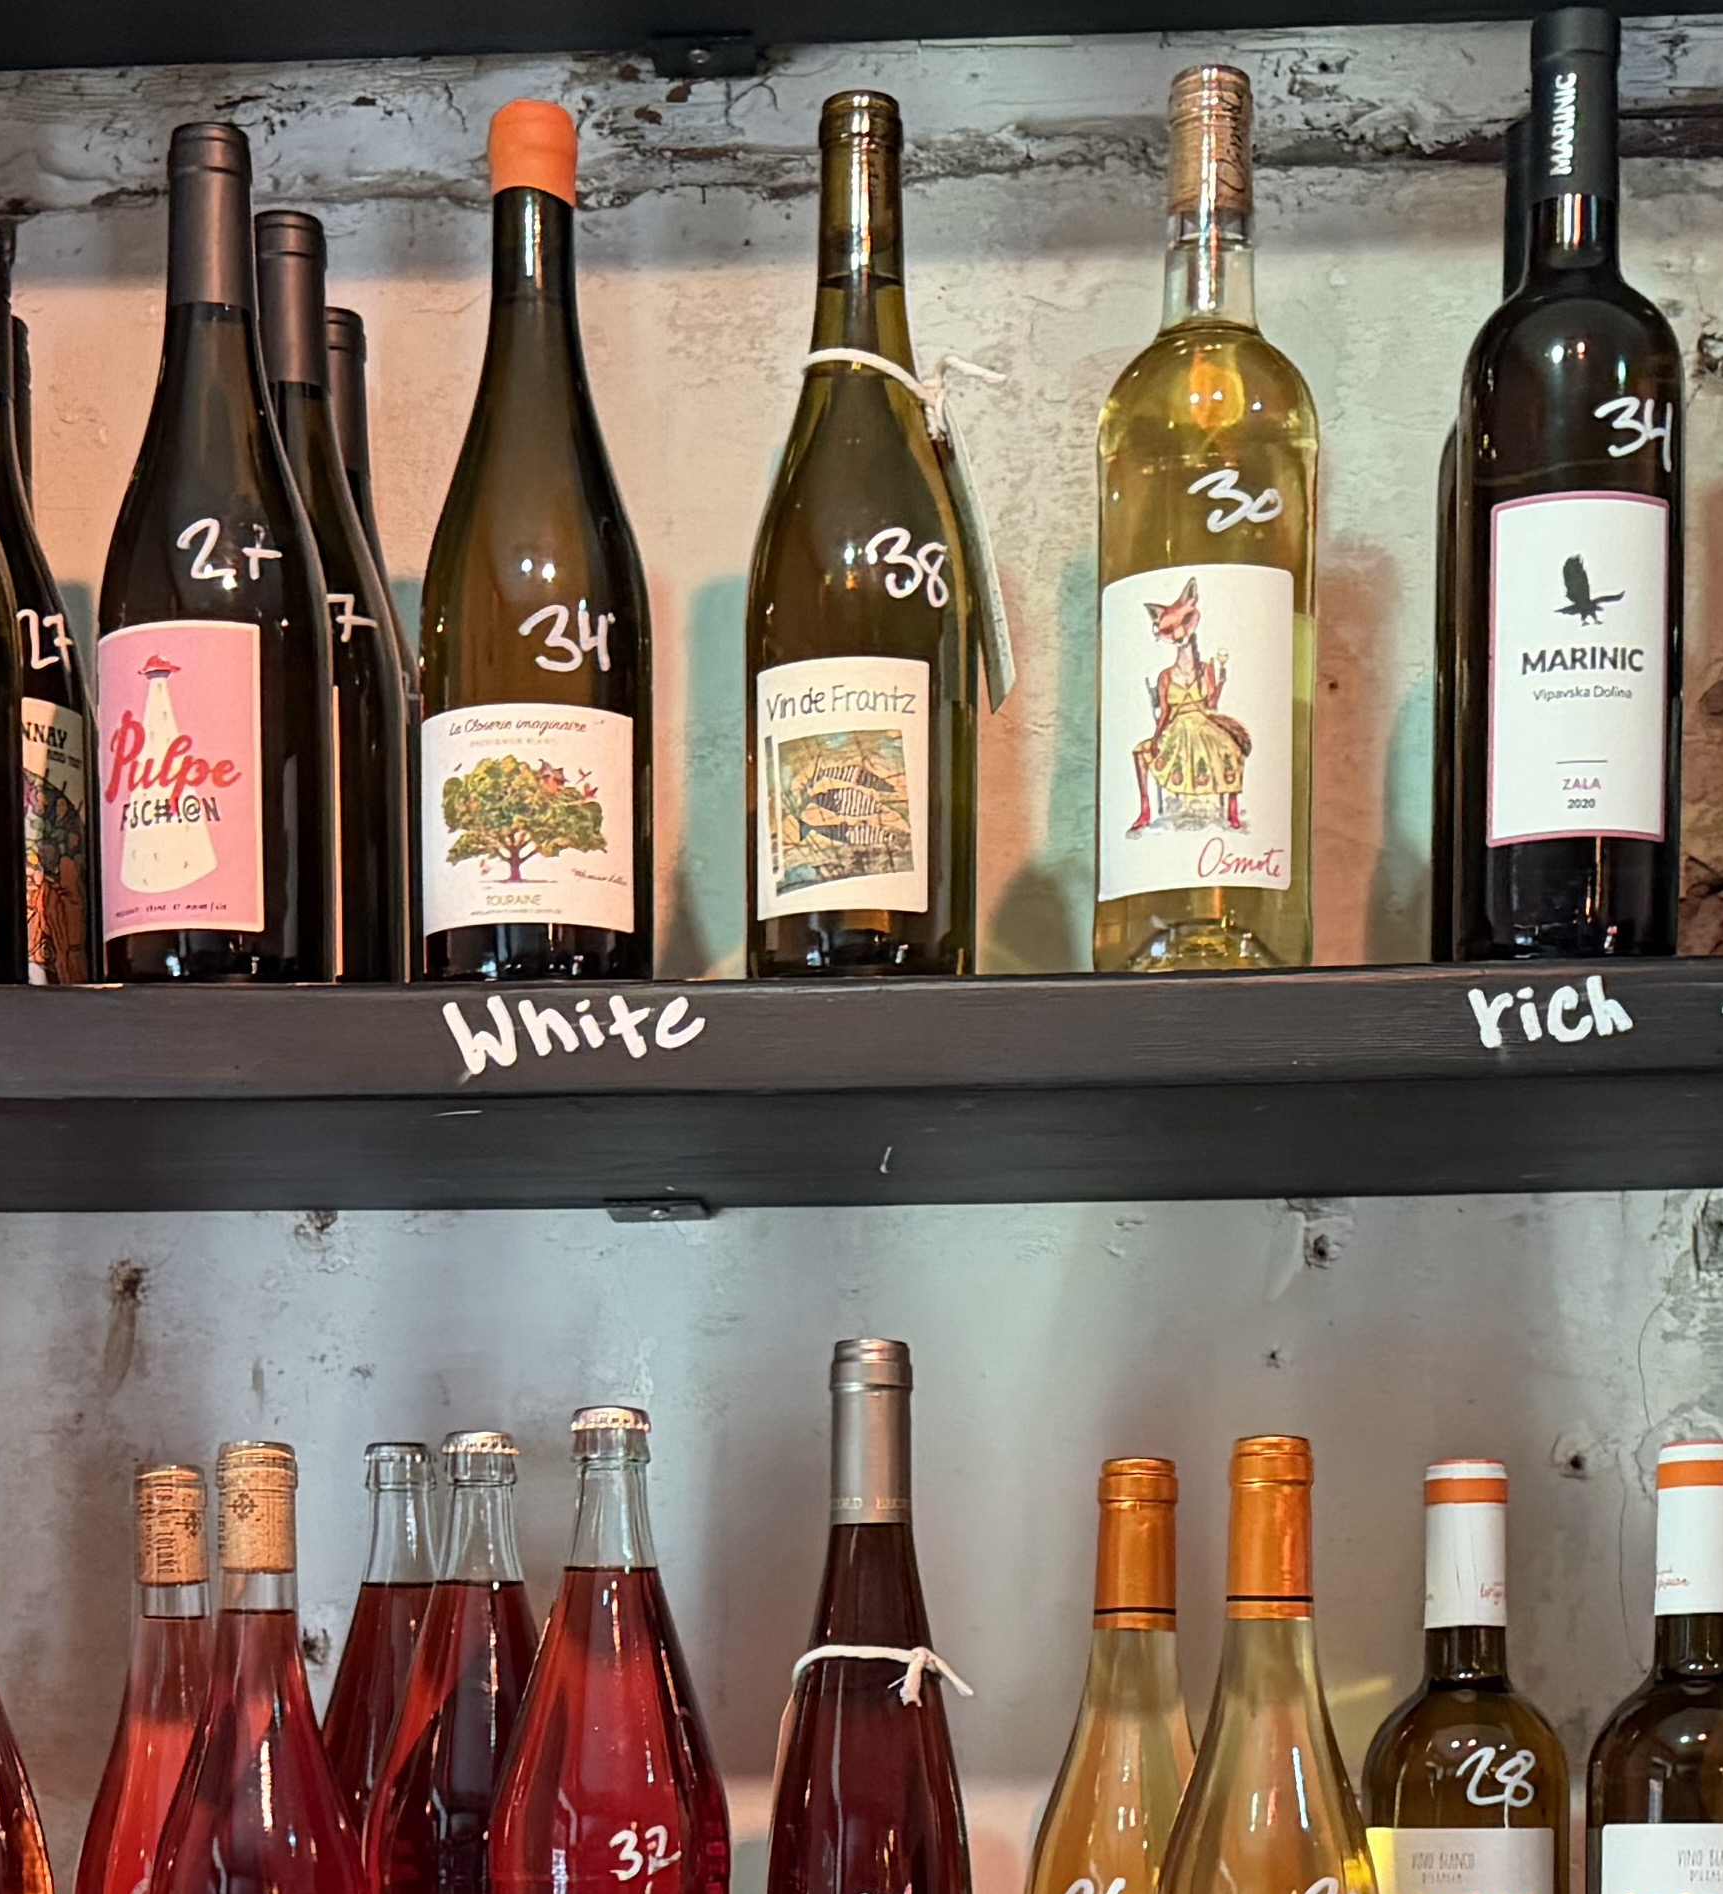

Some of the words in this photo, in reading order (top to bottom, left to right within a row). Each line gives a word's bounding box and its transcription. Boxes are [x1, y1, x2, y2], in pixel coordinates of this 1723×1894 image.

[1549, 72, 1577, 176] MARINIC
[1594, 396, 1673, 472] 34
[1187, 469, 1283, 533] 30
[175, 517, 283, 581] 27
[864, 526, 949, 609] 38
[16, 607, 74, 670] 27
[518, 603, 616, 673] 34
[1521, 645, 1646, 676] MARINIC
[766, 694, 797, 722] Vin
[800, 686, 827, 714] de
[830, 684, 919, 715] Frantz
[1532, 685, 1591, 701] Vipavska
[1593, 684, 1634, 700] Dolina
[104, 710, 242, 814] Pulpe
[1562, 775, 1603, 792] ZALA
[1196, 836, 1281, 880] Osmote
[443, 996, 706, 1076] White
[1468, 976, 1634, 1049] rich
[1456, 1746, 1536, 1807] 28
[609, 1825, 682, 1882] 32
[1411, 1852, 1435, 1871] VINO
[1677, 1849, 1704, 1867] VINO
